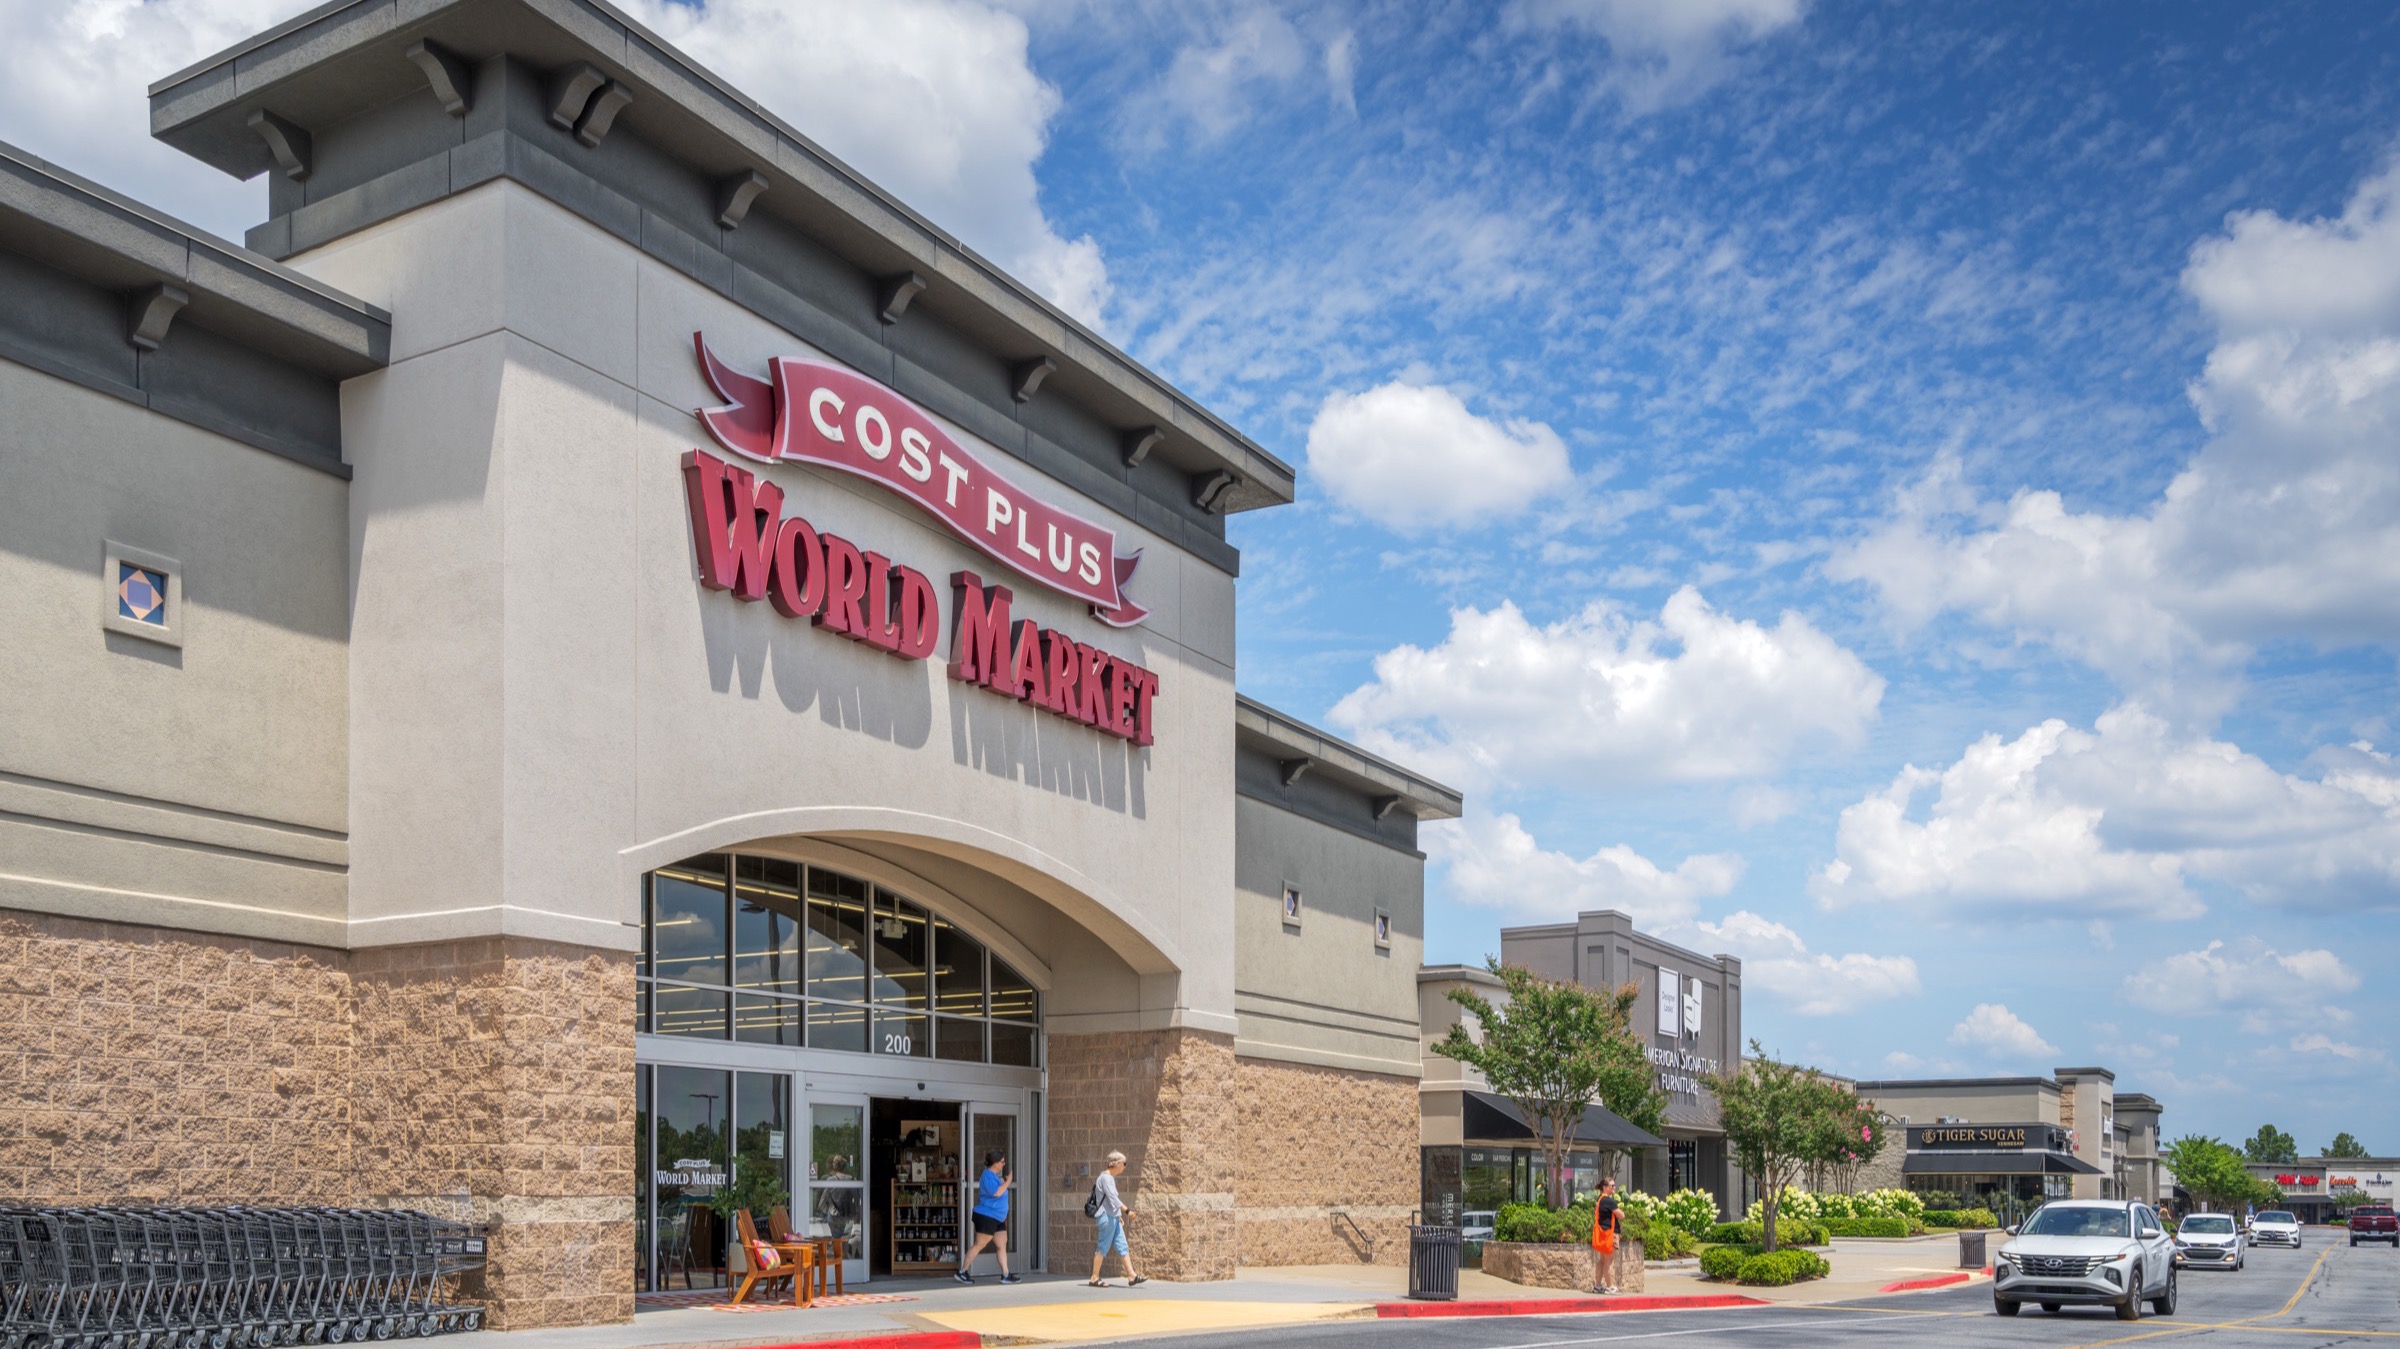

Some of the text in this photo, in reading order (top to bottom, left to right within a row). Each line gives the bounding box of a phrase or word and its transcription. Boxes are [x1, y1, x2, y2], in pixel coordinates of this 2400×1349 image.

[808, 386, 1102, 586] COST PLUS
[680, 449, 1160, 747] WORLD MARKET
[885, 1033, 911, 1055] 200
[1661, 1073, 1699, 1095] FURNITURE
[1937, 1128, 2025, 1142] TIGER SUGAR
[1471, 1153, 1484, 1162] COLOR
[657, 1170, 727, 1185] WORLD MARKET
